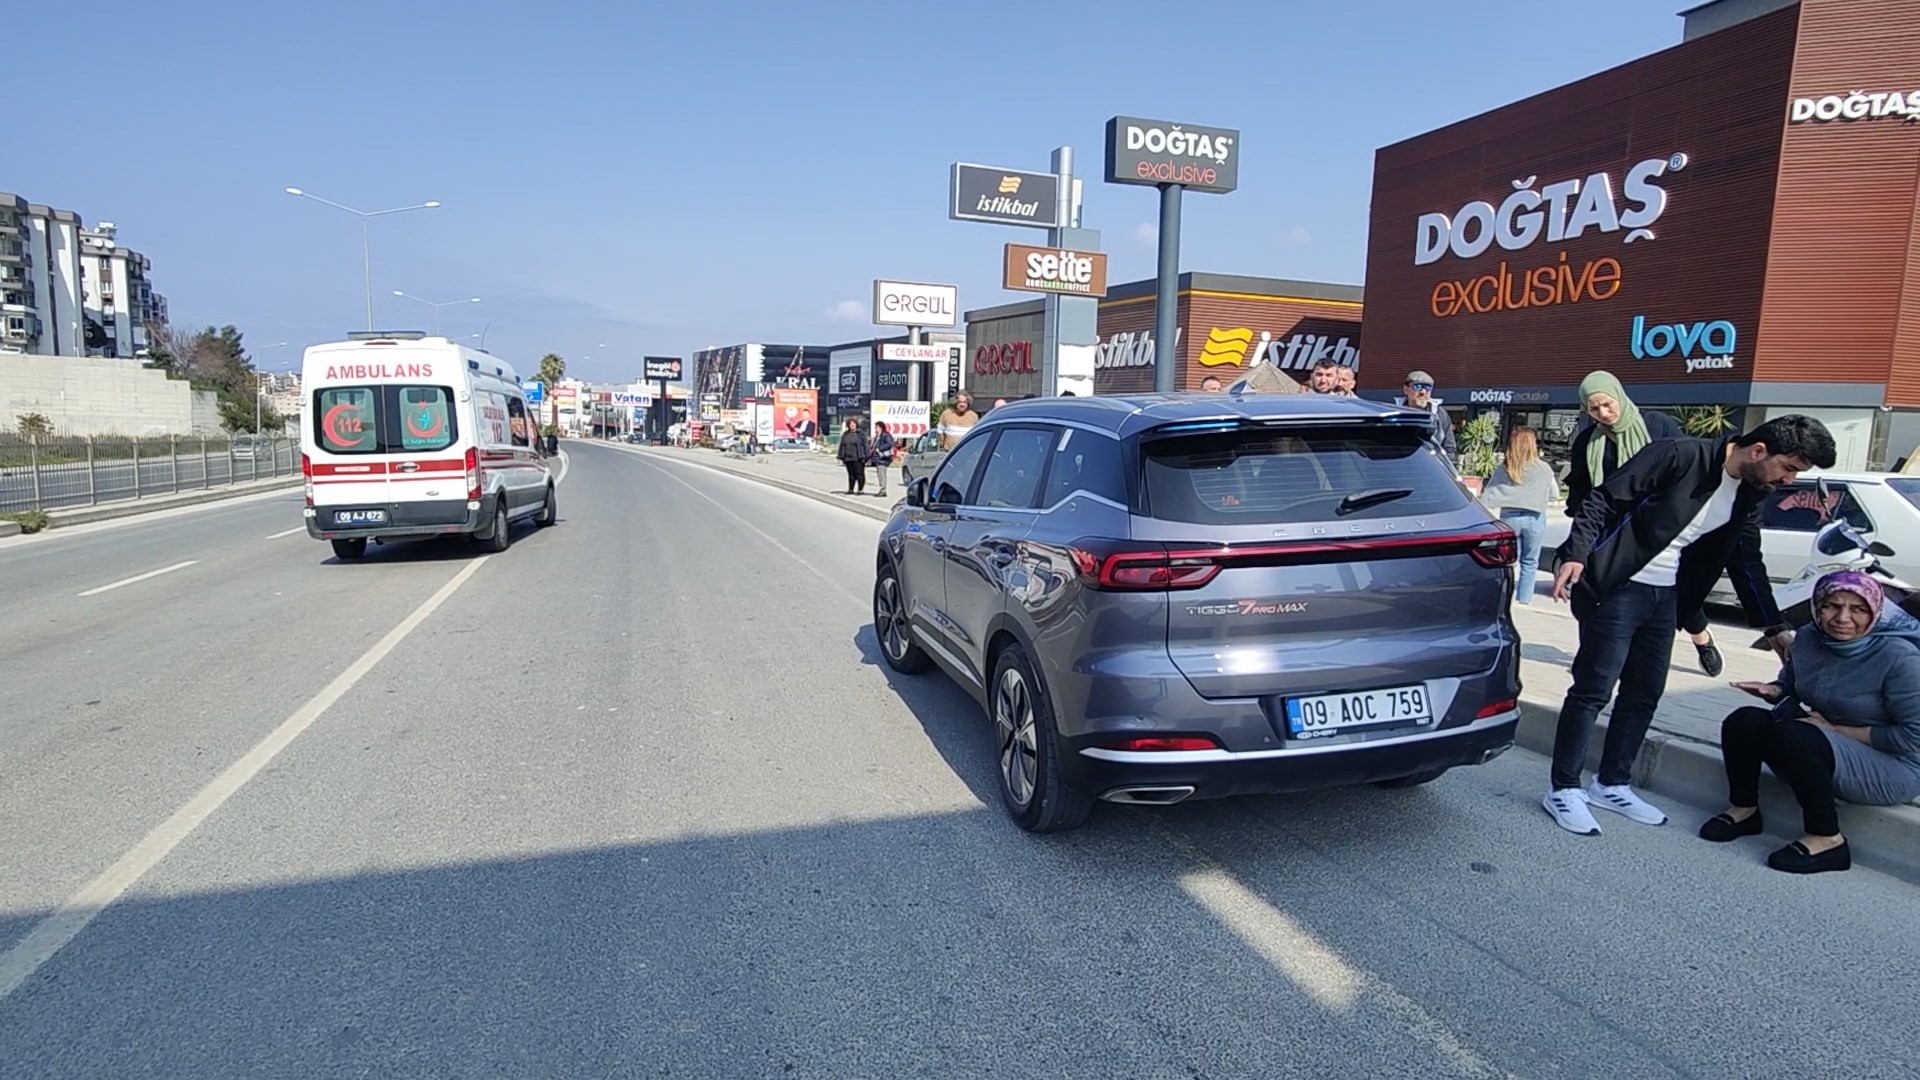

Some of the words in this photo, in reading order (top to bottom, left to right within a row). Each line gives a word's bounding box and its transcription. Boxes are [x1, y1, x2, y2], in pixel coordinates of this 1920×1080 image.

[1127, 125, 1229, 165] DOĞTAŞ
[1137, 160, 1216, 184] exclusive
[976, 194, 1039, 217] istikbal
[1026, 250, 1092, 283] sette
[1431, 251, 1622, 317] exclusive
[1631, 315, 1736, 359] lova
[895, 347, 948, 358] CEYLANLAR
[1249, 330, 1360, 373] istikb
[326, 364, 433, 380] AMBULANS
[1686, 354, 1734, 374] yatak
[879, 371, 907, 386] saloon
[614, 394, 650, 403] Vatan
[1470, 389, 1513, 403] DOĞTAŞ
[888, 404, 928, 416] istikbal
[338, 417, 363, 433] 112
[1273, 519, 1428, 537] CHERY
[1302, 700, 1328, 727] 09
[1386, 689, 1424, 718] 759
